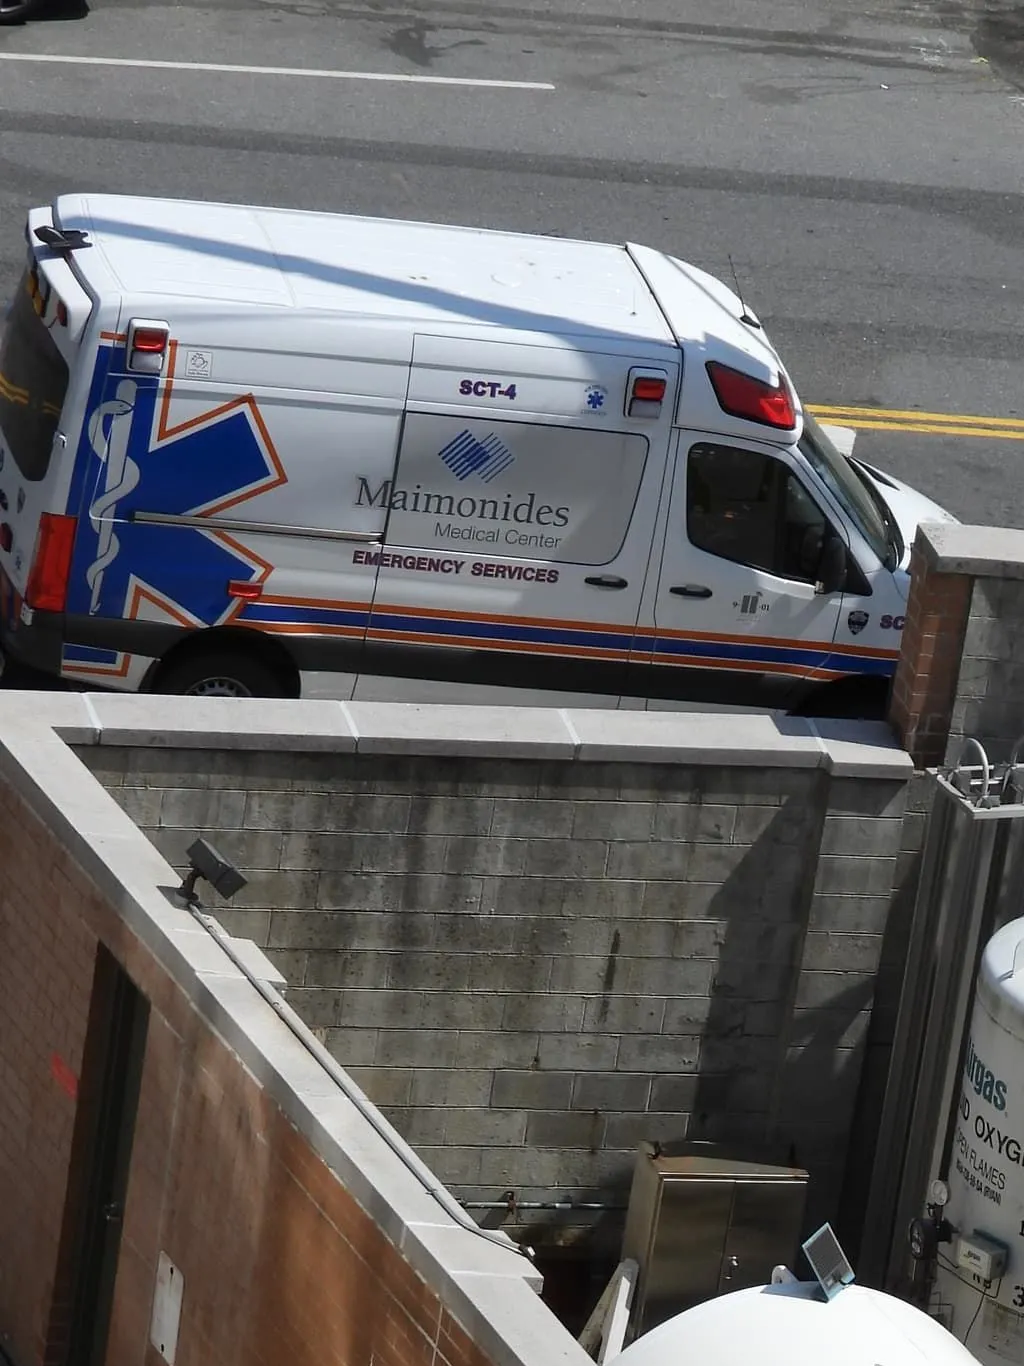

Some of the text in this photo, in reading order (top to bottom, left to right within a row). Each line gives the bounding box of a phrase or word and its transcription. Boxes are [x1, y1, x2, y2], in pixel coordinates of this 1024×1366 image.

[459, 379, 517, 400] SCT-4
[354, 476, 570, 528] Maimonides
[434, 522, 563, 549] Medical Center
[352, 550, 560, 583] EMERGENCY SERVICES
[880, 614, 905, 630] SC
[968, 1148, 1006, 1190] FLAMES
